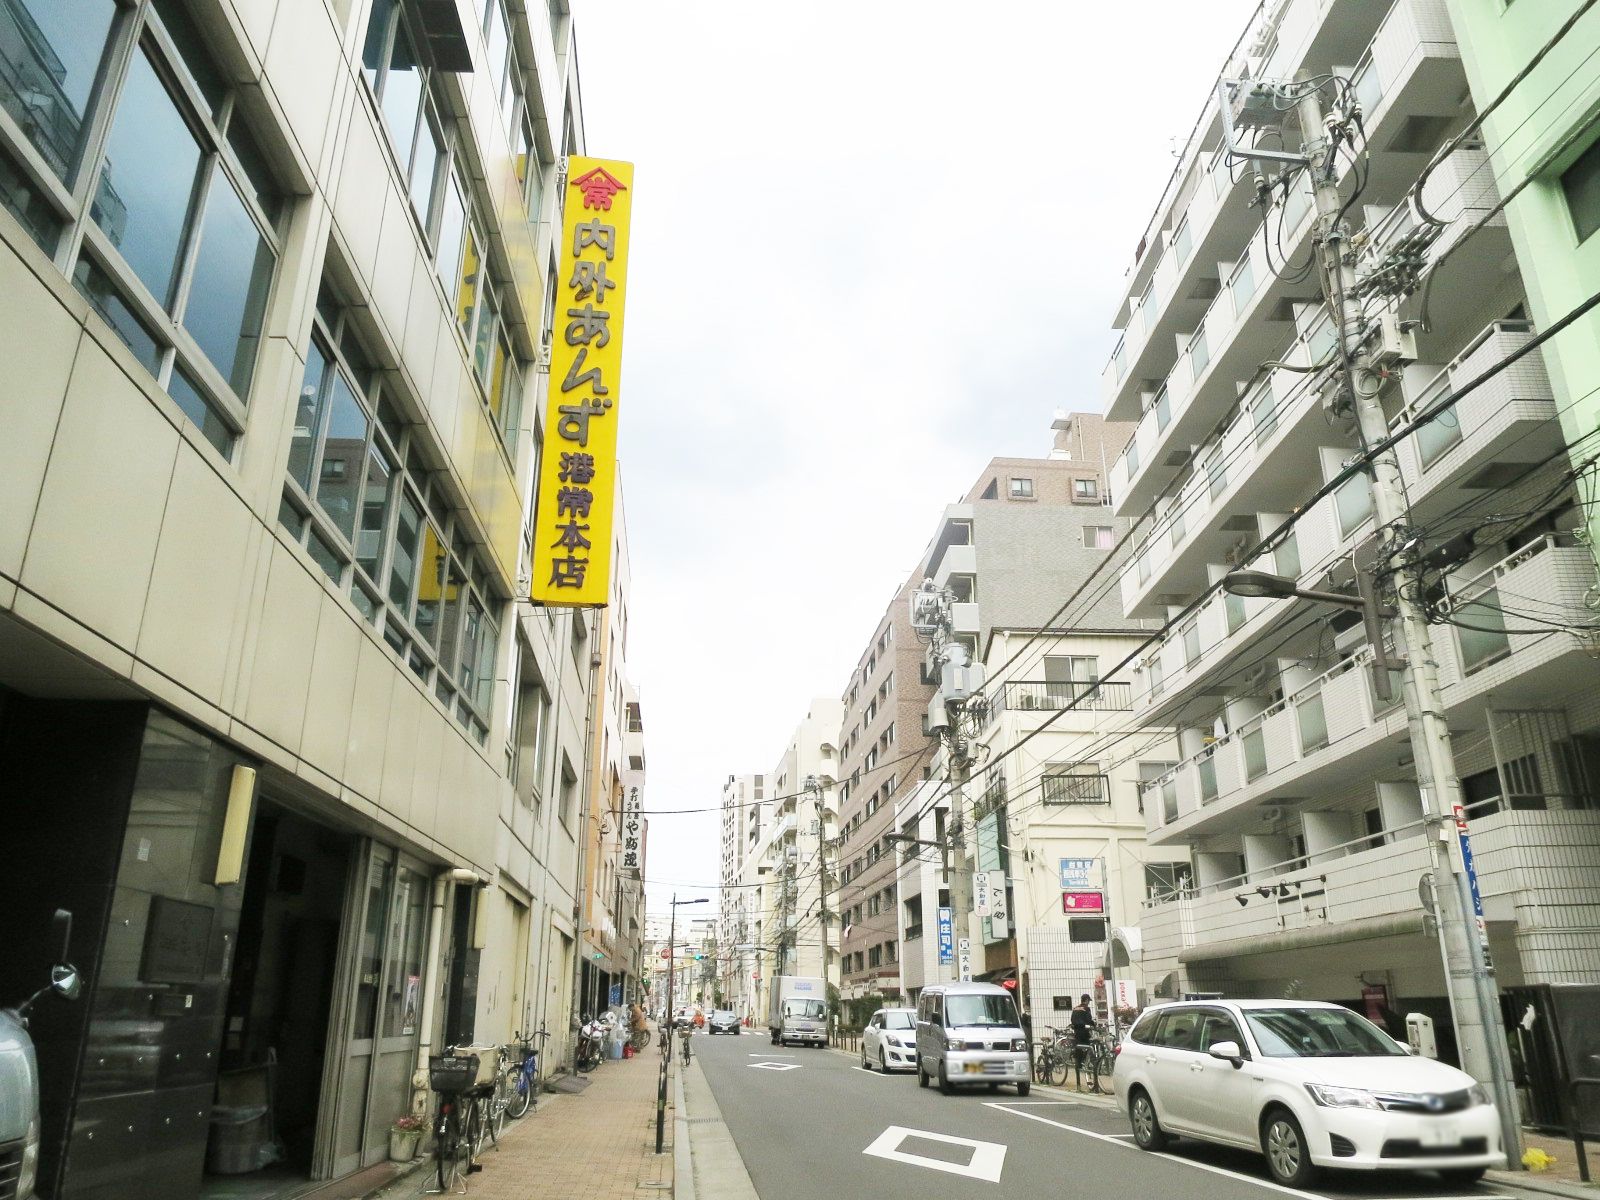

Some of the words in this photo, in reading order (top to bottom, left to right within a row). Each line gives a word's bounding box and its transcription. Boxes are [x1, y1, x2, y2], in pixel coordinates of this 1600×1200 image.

[557, 217, 617, 447] 内外あんず
[547, 451, 596, 589] 港常本店
[992, 887, 1005, 920] でん助
